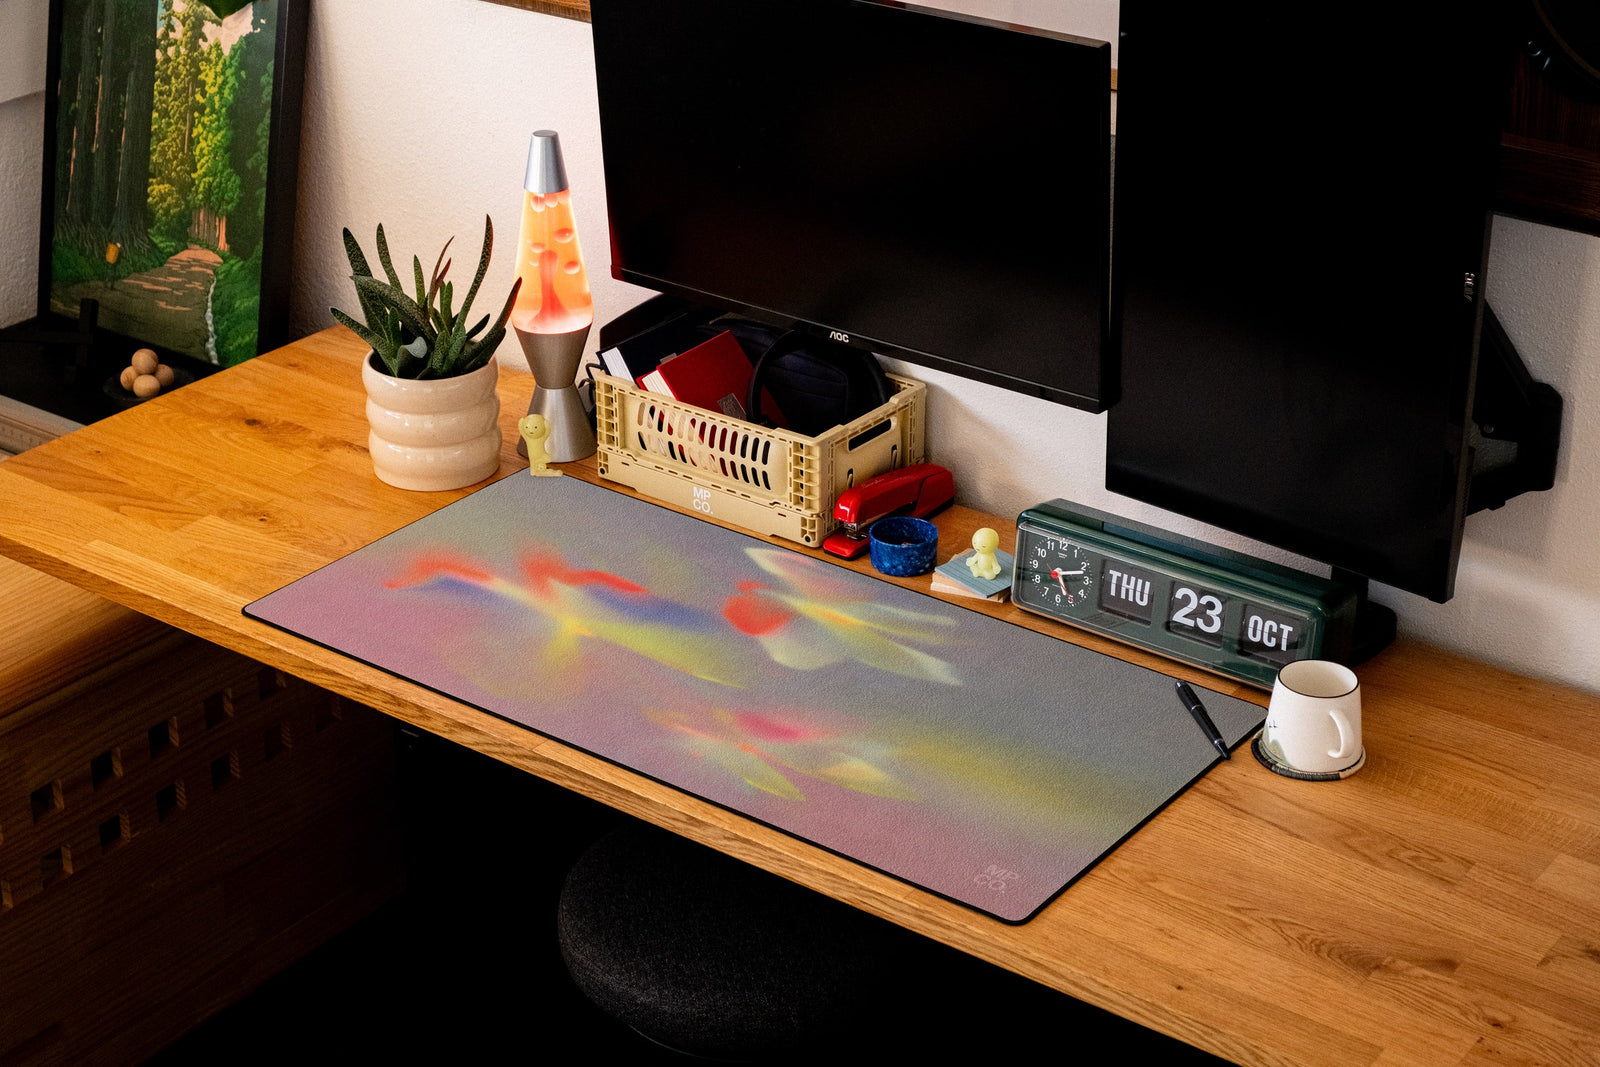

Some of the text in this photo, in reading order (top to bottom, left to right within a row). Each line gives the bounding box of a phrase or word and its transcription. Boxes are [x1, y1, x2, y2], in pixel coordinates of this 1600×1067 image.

[829, 331, 849, 343] AOC
[693, 486, 711, 500] MP
[693, 499, 714, 514] CO.
[1047, 541, 1055, 550] 11
[1060, 541, 1068, 551] 12
[1037, 548, 1046, 558] 10
[1074, 549, 1078, 558] 1
[1032, 560, 1039, 568] 9
[1081, 562, 1087, 571] 2
[1035, 575, 1041, 583] 8
[1083, 576, 1089, 585] 3
[1044, 586, 1049, 595] 7
[1078, 589, 1084, 598] 4
[1055, 594, 1061, 603] 6
[1109, 569, 1293, 651] THU 23 OCT
[984, 864, 1020, 881] MP
